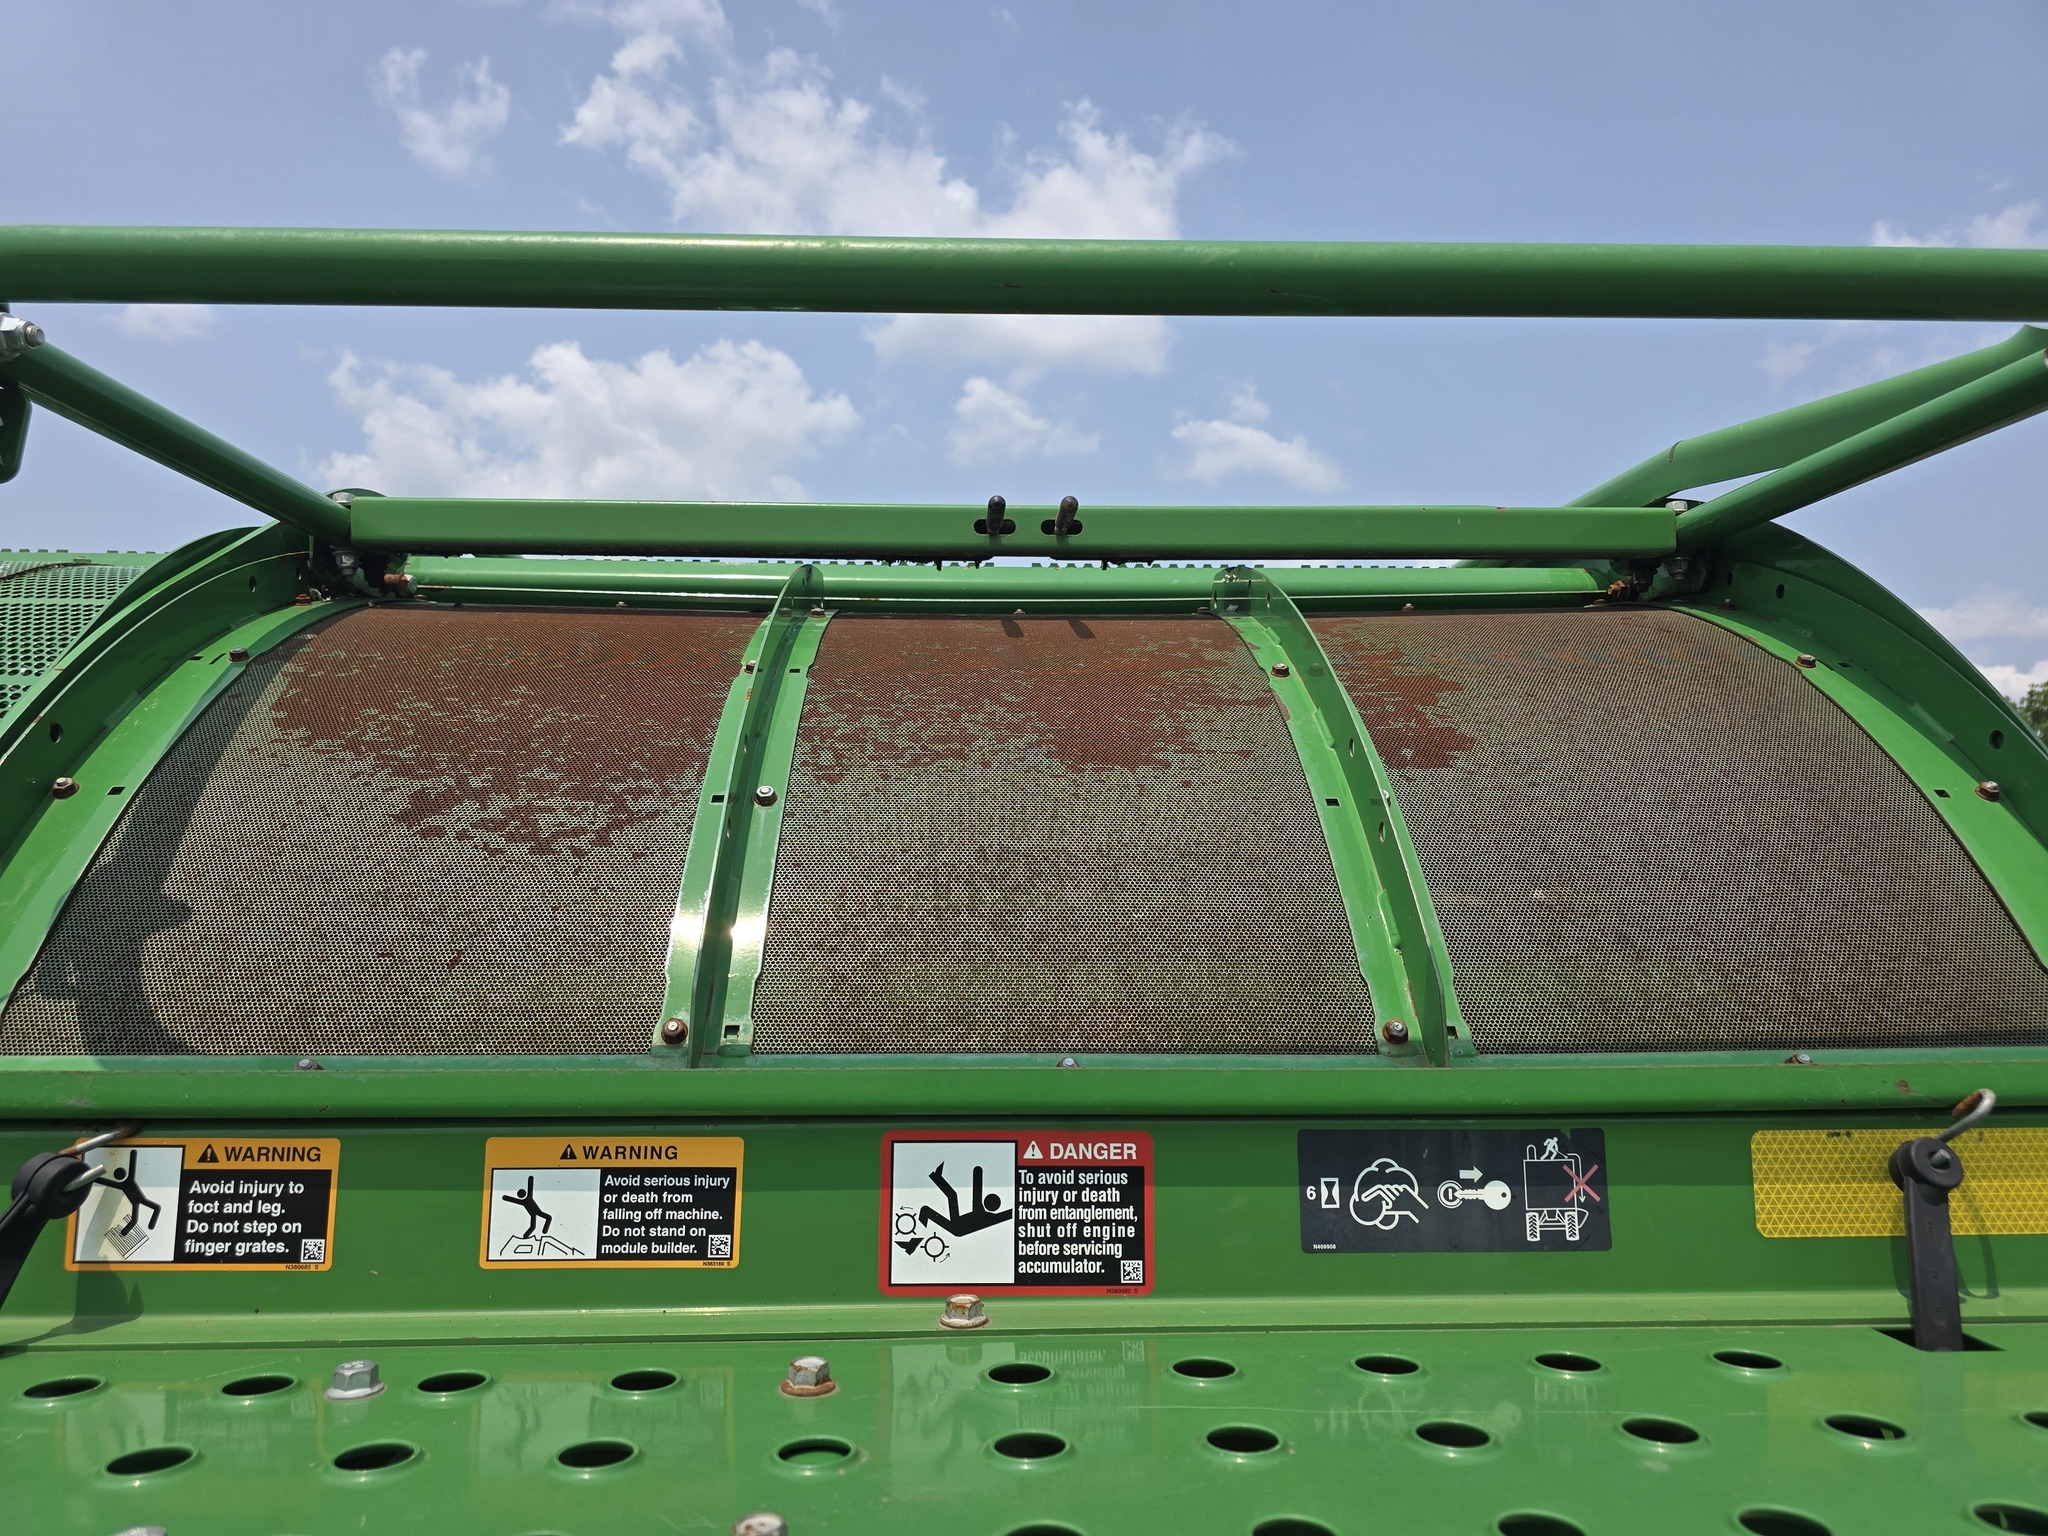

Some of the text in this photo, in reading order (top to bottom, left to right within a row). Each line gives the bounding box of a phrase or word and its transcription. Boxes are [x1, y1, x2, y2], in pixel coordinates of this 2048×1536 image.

[225, 1147, 321, 1162] WARNING
[583, 1146, 677, 1160] WARNING
[1051, 1143, 1136, 1159] DANGER
[605, 1174, 731, 1190] Avoid serious injury
[1019, 1170, 1128, 1184] To avoid serious
[190, 1181, 304, 1197] Avoid injury to
[1019, 1187, 1120, 1205] injury or death
[1306, 1186, 1316, 1200] 6
[604, 1192, 692, 1203] or death from
[223, 1200, 253, 1213] and
[258, 1200, 285, 1216] leg.
[603, 1208, 722, 1222] falling off machine.
[1018, 1205, 1137, 1223] from entanglement,
[187, 1220, 301, 1236] Do not step on
[603, 1225, 706, 1236] Do not stand on
[1018, 1223, 1135, 1240] shut off engine
[185, 1239, 289, 1256] finger grates.
[602, 1242, 697, 1253] module builder.
[1019, 1241, 1122, 1258] before servicing
[1018, 1258, 1104, 1273] accumulator.
